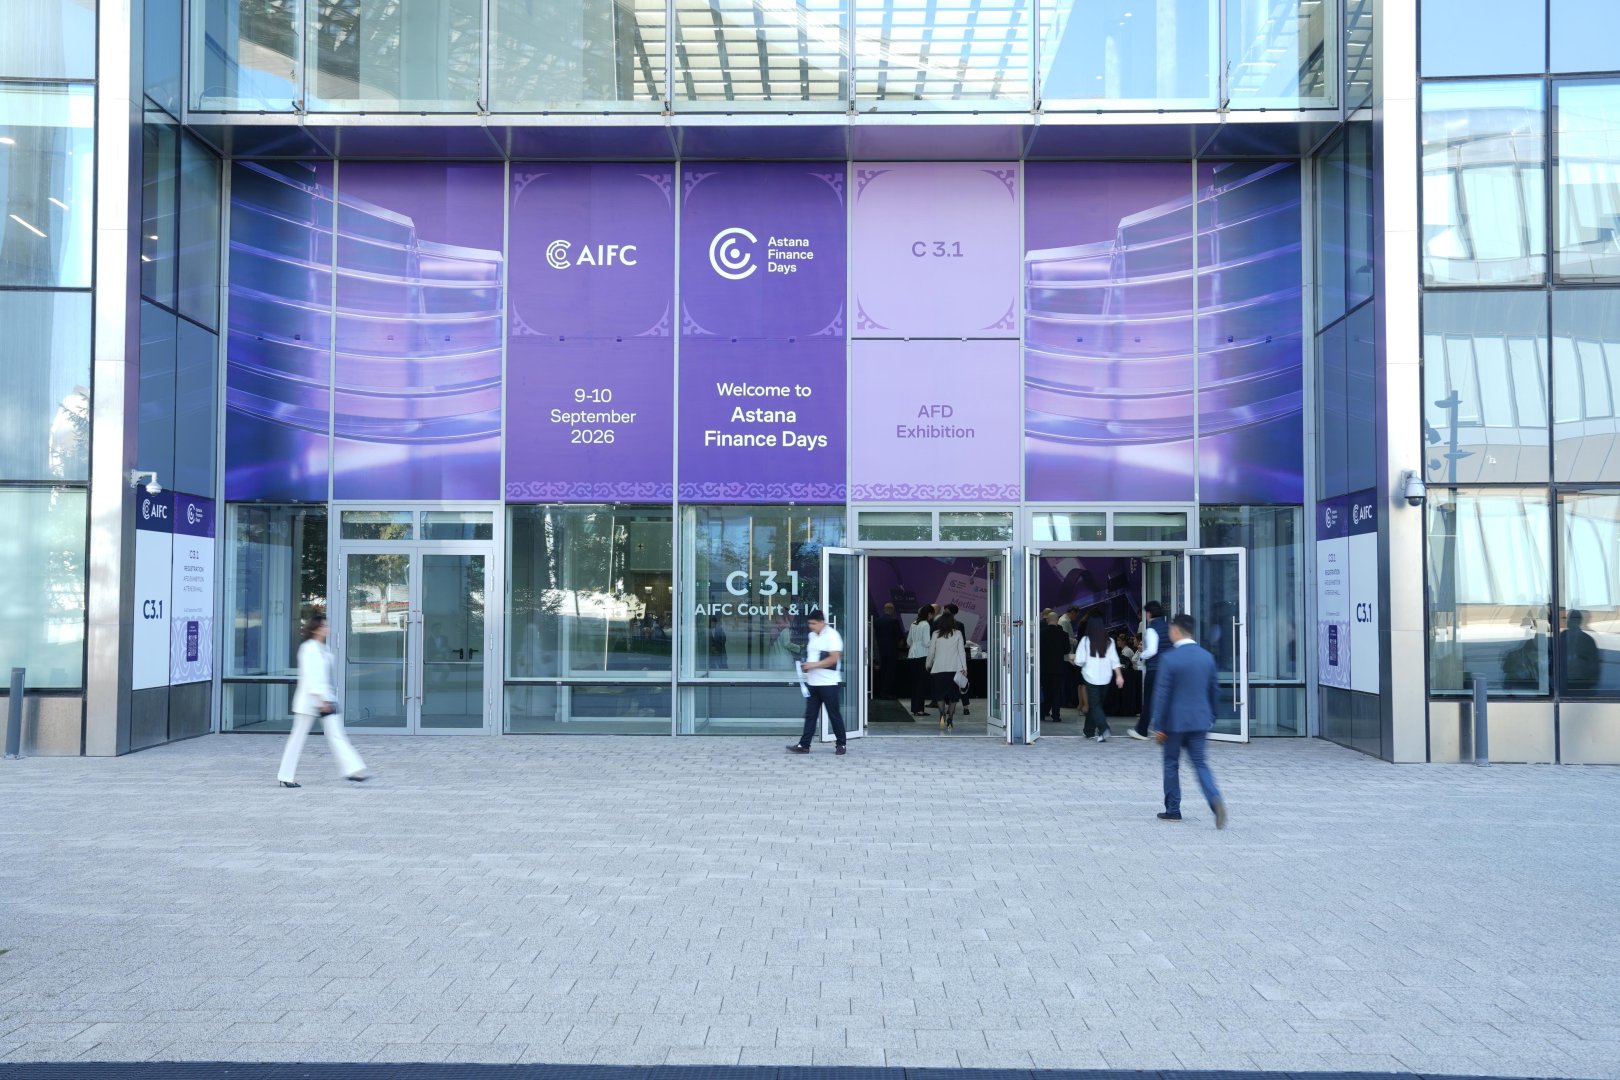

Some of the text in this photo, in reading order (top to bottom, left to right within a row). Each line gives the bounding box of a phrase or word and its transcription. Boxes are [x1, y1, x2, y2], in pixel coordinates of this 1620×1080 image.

[768, 237, 809, 246] Astana
[576, 245, 637, 265] AIFC
[768, 249, 813, 259] Finance
[912, 242, 963, 257] C 3.1
[768, 262, 796, 274] Days
[575, 389, 611, 402] 9-10
[717, 383, 811, 396] Welcome to
[551, 409, 636, 426] September
[731, 407, 796, 422] Astana
[918, 405, 953, 418] AFD
[571, 430, 614, 443] 2026
[897, 425, 974, 438] Exhibition
[705, 431, 827, 451] Finance Days
[151, 505, 167, 519] AIFC
[1359, 504, 1373, 521] AIFC
[726, 570, 799, 596] C 3.1
[143, 600, 163, 620] C3.1
[695, 603, 733, 616] AIFC
[738, 603, 783, 616] Court
[788, 603, 799, 616] &
[1356, 602, 1372, 623] C3.1
